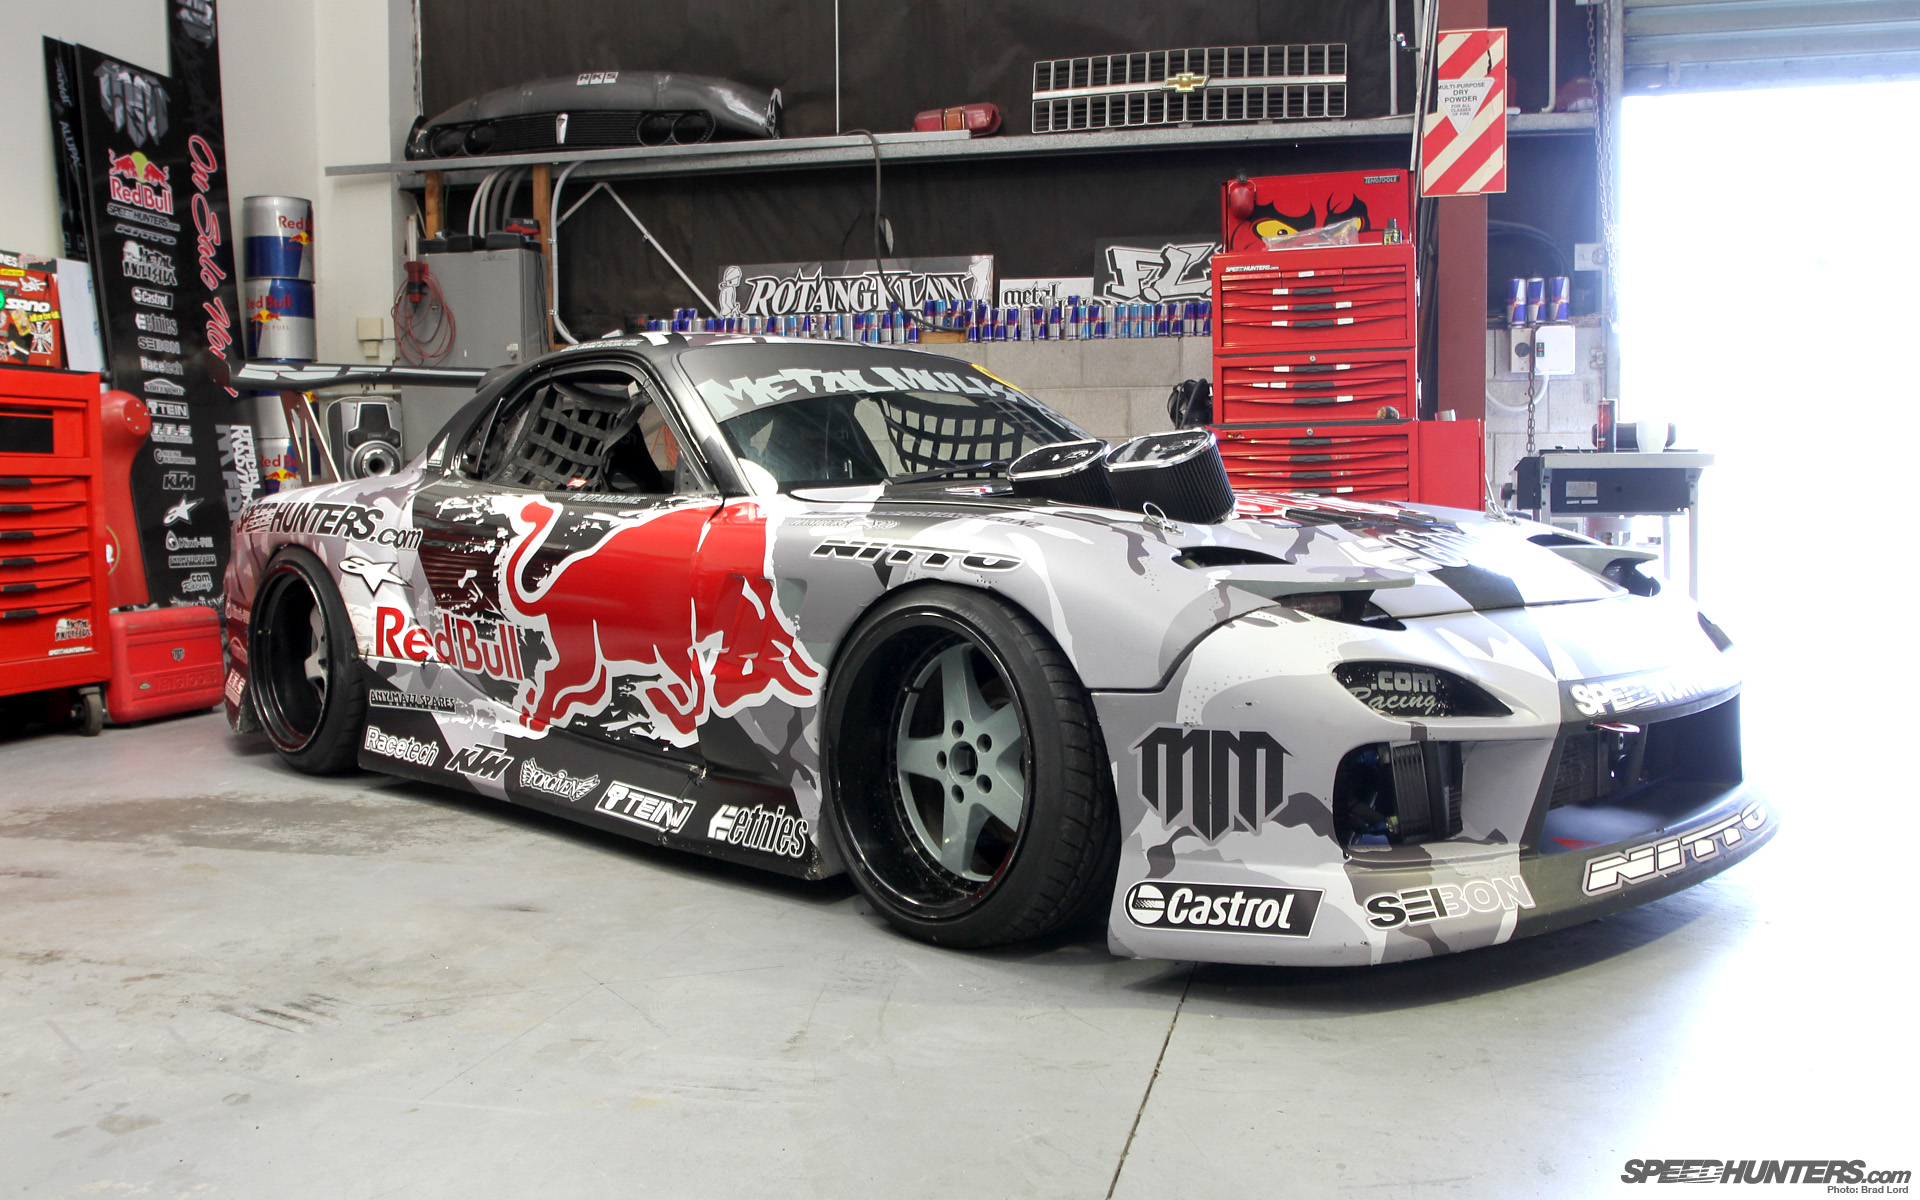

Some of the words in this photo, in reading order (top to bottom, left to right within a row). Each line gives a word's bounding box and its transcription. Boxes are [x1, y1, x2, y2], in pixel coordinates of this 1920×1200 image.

[576, 72, 619, 85] HKS
[187, 134, 217, 193] On
[109, 175, 143, 207] Red
[143, 184, 173, 215] Bull
[279, 215, 303, 231] Red
[191, 193, 226, 291] Sale
[138, 245, 176, 270] METAL
[1226, 264, 1279, 272] SPEEDHUNTERS.com
[141, 290, 168, 306] Castrol
[264, 295, 291, 308] Bull
[1002, 282, 1062, 309] metal
[145, 314, 178, 335] etnies
[138, 336, 180, 354] SEIBON
[140, 356, 183, 375] Racetech
[696, 367, 895, 418] METAL
[158, 403, 188, 416] TEIN
[162, 471, 195, 490] KTM
[236, 502, 424, 550] SPEEDHUNTERS.com
[811, 539, 1025, 573] NITTO
[376, 606, 456, 668] Red
[455, 617, 524, 681] Bull
[1370, 671, 1437, 692] .com
[370, 690, 389, 702] ANY
[391, 692, 418, 705] MAZZ
[420, 695, 455, 710] SPARES
[364, 726, 439, 768] Racetech
[446, 743, 514, 780] KTM
[625, 792, 690, 828] TEIN
[728, 803, 808, 859] etnies
[1582, 801, 1768, 896] NITTO
[1167, 890, 1296, 931] Castrol
[1365, 875, 1537, 931] SEIBON
